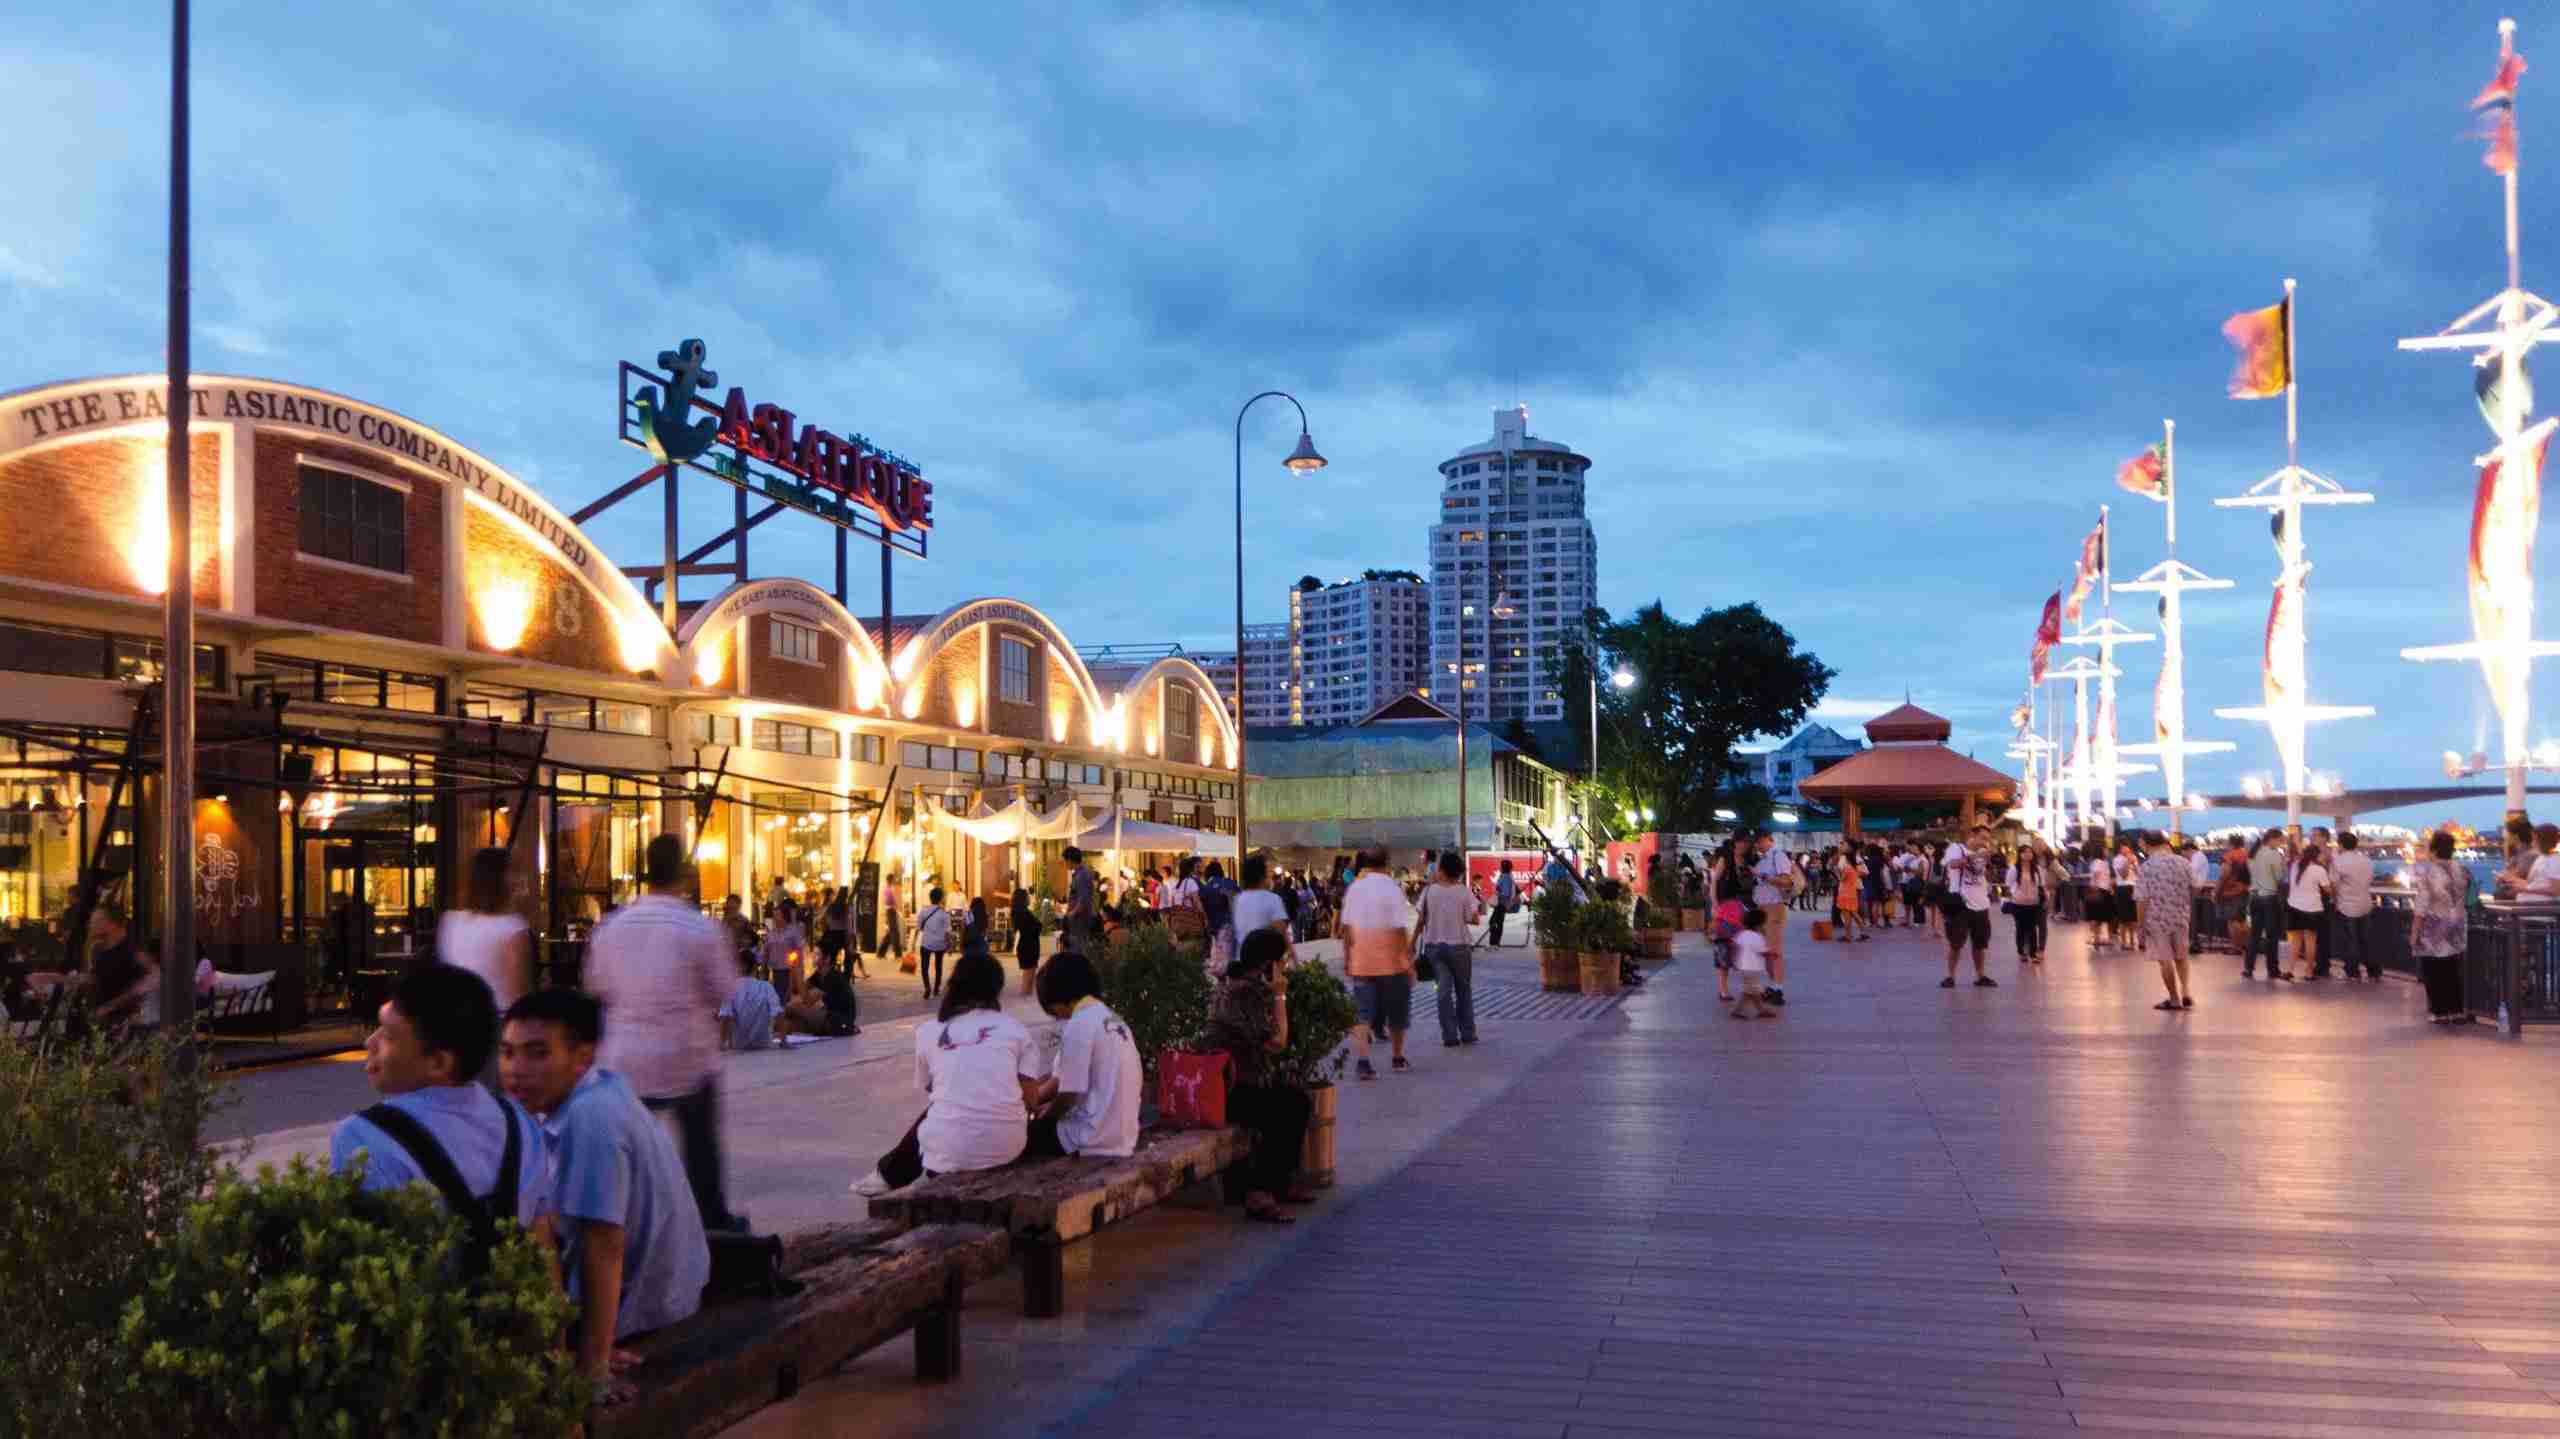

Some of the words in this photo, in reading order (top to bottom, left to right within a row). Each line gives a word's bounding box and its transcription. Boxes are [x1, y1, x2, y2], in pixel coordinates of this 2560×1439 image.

[20, 392, 107, 438] THE
[114, 388, 210, 420] EAT
[223, 389, 351, 434] ASIATIC
[358, 413, 491, 492] COMPANY
[495, 481, 588, 567] LIMITED
[717, 386, 933, 530] ASIATIQUE
